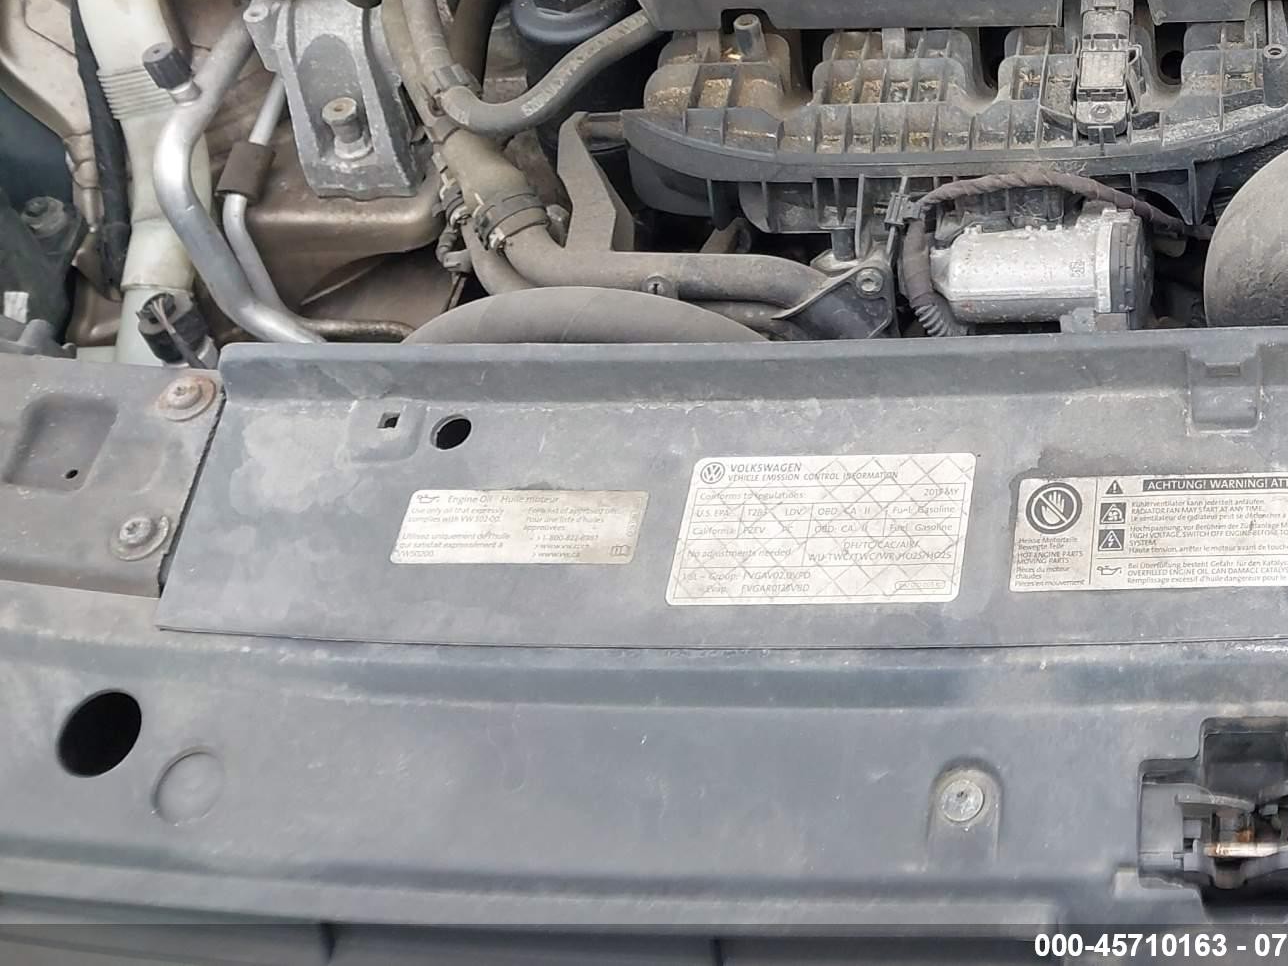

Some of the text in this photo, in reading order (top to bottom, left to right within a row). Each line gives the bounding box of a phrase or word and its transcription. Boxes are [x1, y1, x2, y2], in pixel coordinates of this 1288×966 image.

[729, 463, 802, 473] VOLKSWAGEN
[728, 471, 899, 482] VEHICLE EMISSION CONTROL INFORMATION
[1147, 479, 1207, 491] ACHTUNG!
[1209, 478, 1269, 489] WARNING!
[447, 494, 479, 506] Engine
[479, 494, 493, 504] Oil
[525, 496, 559, 504] moteur
[699, 492, 742, 501] Conforms
[695, 508, 712, 517] U.S.
[917, 505, 956, 514] Gasoline
[1181, 506, 1198, 514] MAY
[460, 515, 474, 523] VW
[914, 522, 953, 531] Gasoline
[1210, 530, 1224, 538] OFF
[687, 548, 792, 559] No adjustments needed
[1127, 569, 1168, 577] OVERFILLED
[1168, 568, 1196, 576] ENGINE
[1211, 567, 1227, 575] CAN
[1262, 574, 1279, 583] pour
